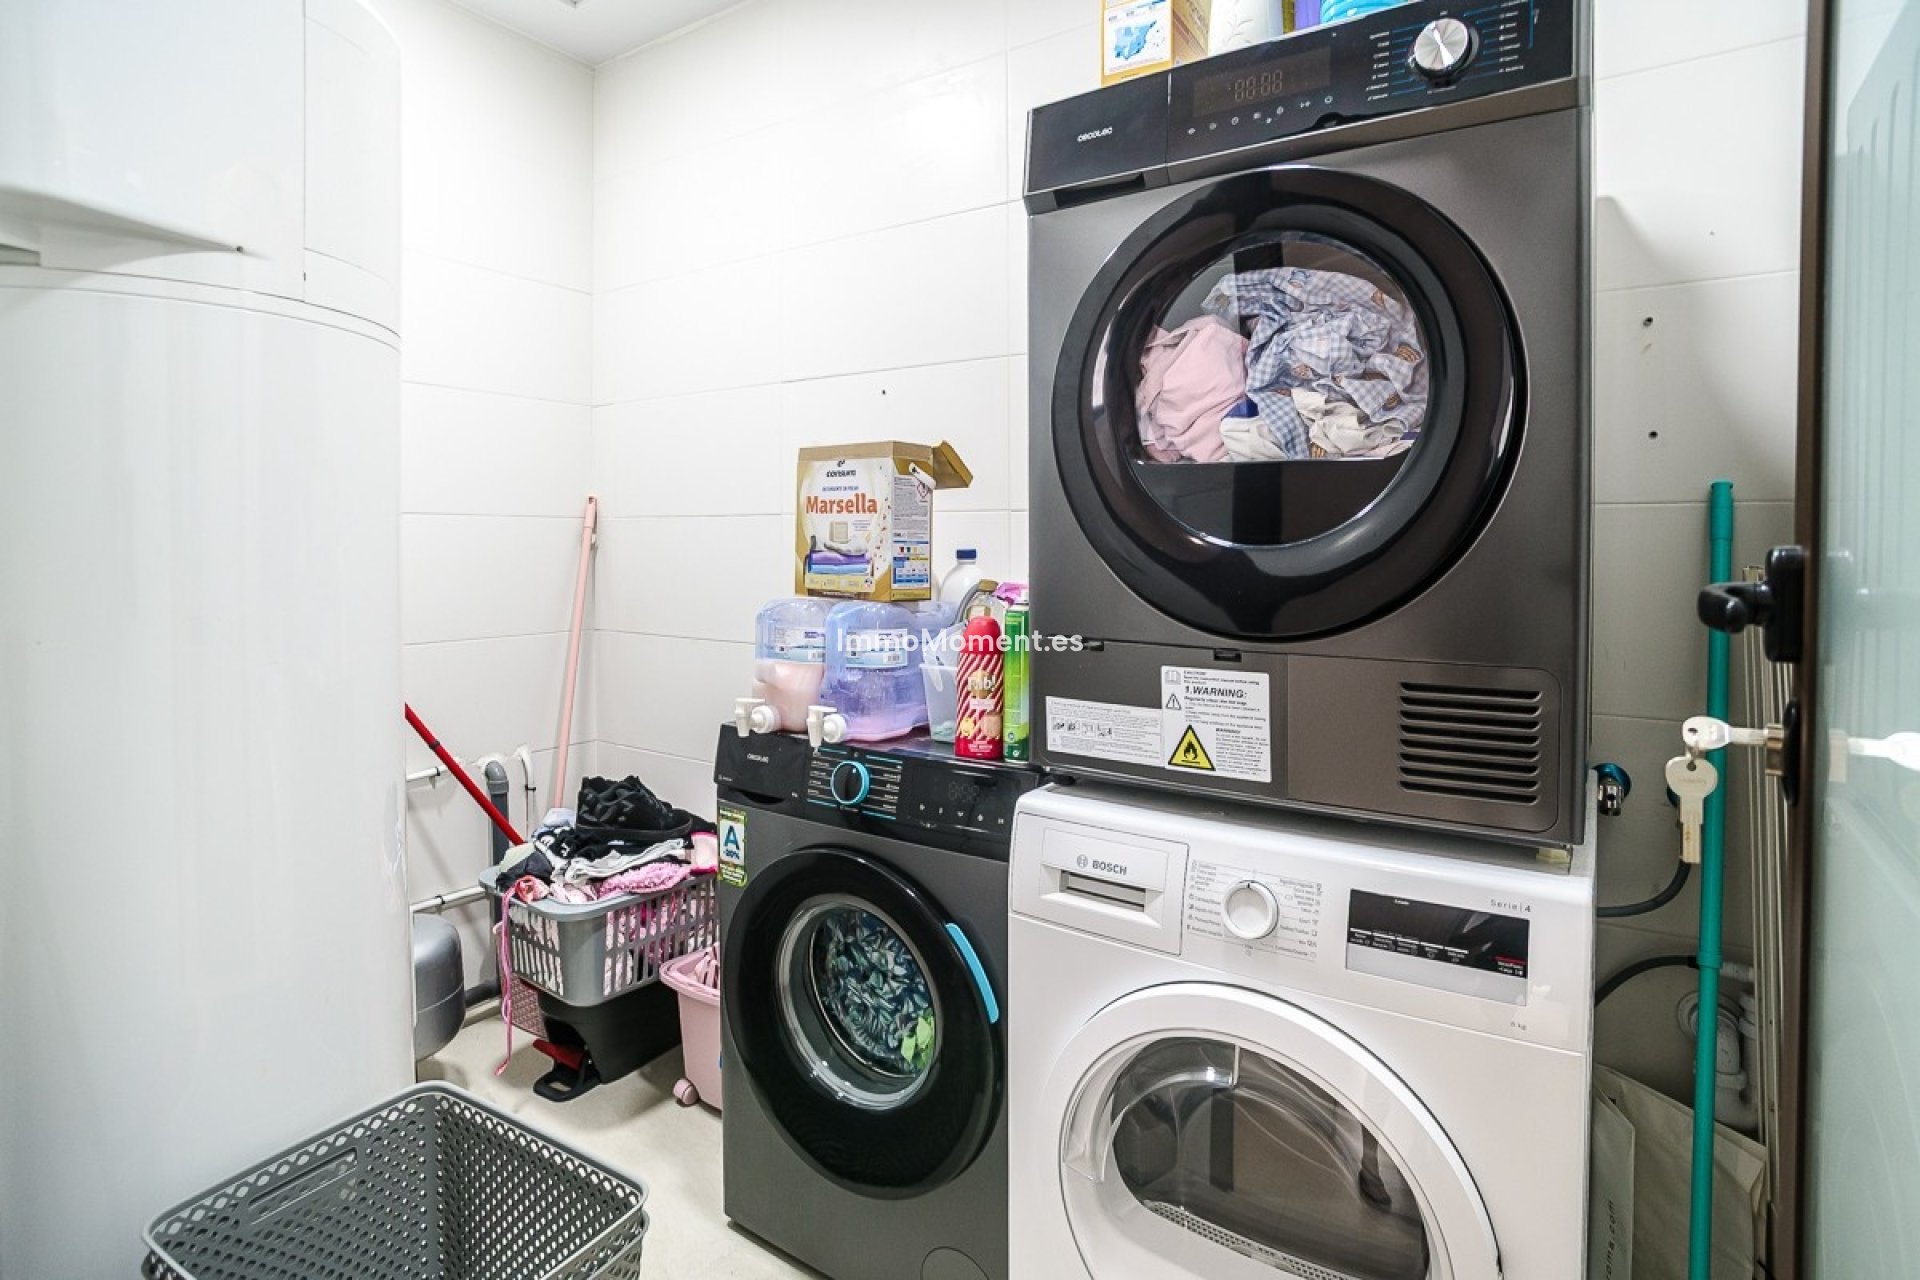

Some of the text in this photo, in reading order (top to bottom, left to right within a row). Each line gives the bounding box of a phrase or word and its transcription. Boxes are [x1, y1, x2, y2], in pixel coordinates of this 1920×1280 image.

[806, 492, 878, 514] Marsella
[724, 825, 740, 850] A
[1092, 860, 1127, 875] BOSCH
